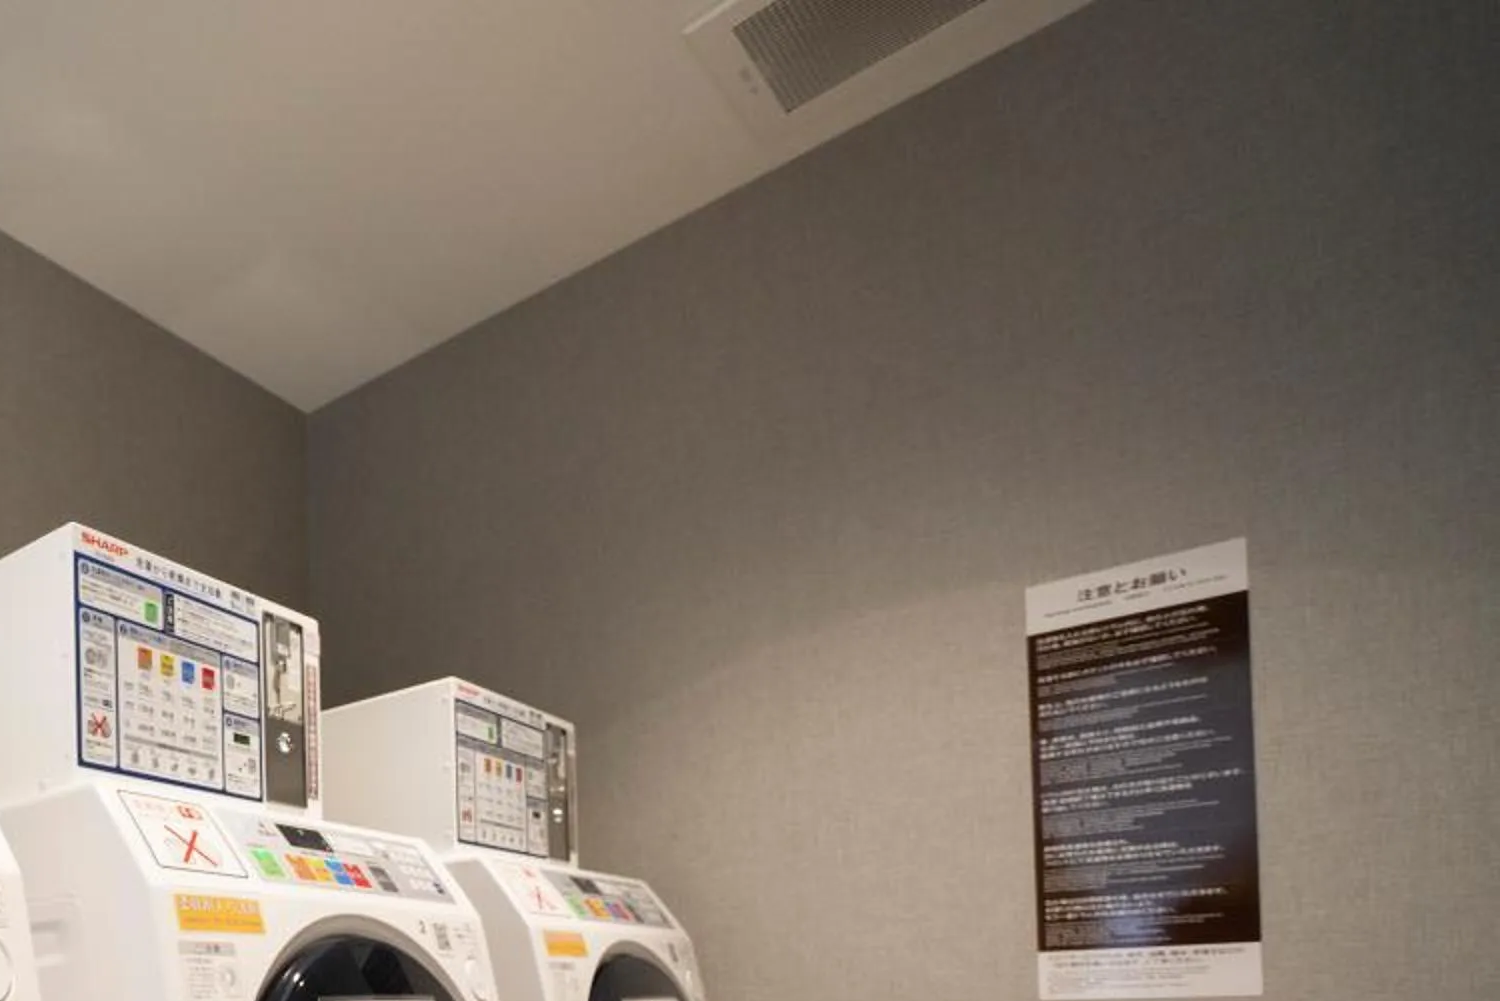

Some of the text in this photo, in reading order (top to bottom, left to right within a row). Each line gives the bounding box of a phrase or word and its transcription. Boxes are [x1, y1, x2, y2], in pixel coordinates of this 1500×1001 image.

[81, 531, 130, 557] SHARP
[1077, 567, 1188, 602] 注意とお願い
